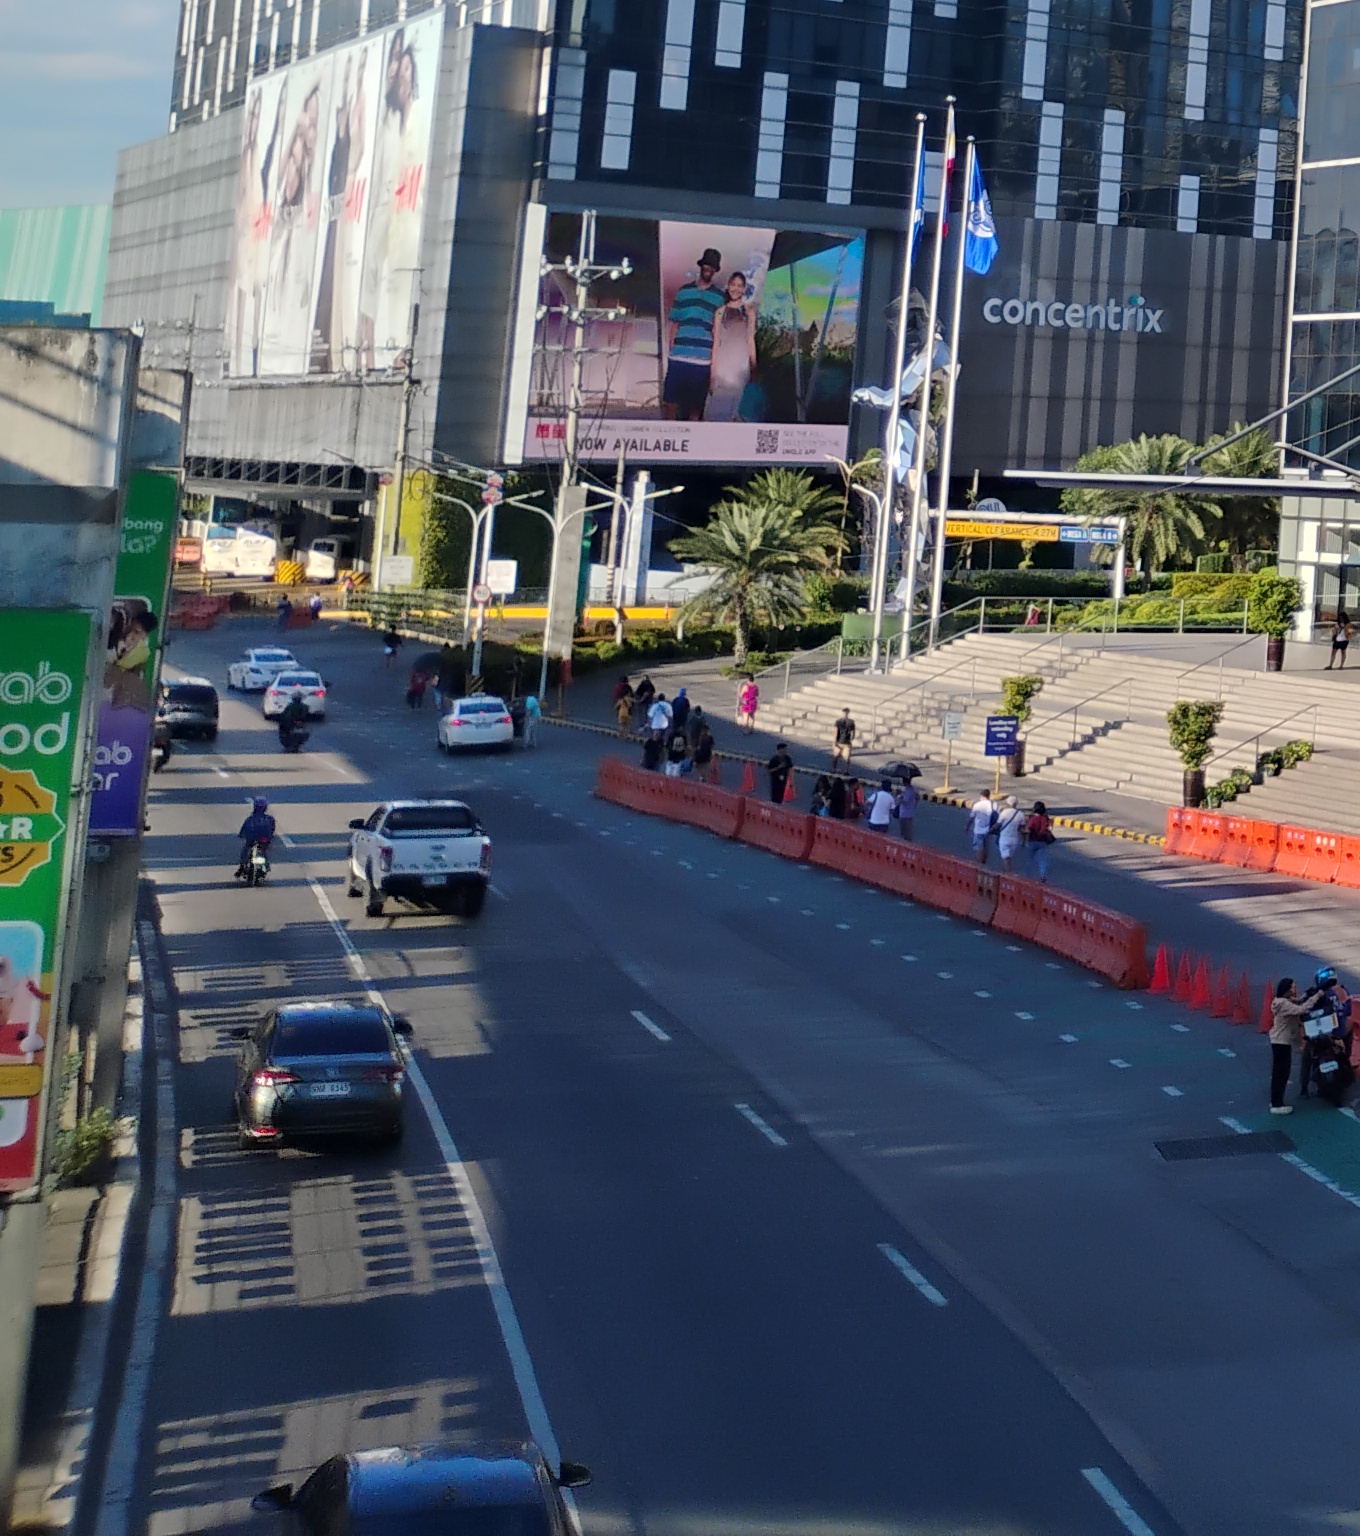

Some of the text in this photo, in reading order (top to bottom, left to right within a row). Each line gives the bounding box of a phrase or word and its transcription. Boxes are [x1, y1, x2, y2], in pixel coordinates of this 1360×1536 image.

[983, 296, 1164, 334] concentrix
[577, 437, 690, 453] NOW AVAILABLE
[946, 521, 981, 534] VERTICAL
[985, 524, 1031, 537] CLEARANCE
[121, 534, 157, 554] la?
[0, 660, 73, 705] ab
[0, 711, 71, 755] od
[95, 739, 133, 766] ab
[90, 773, 119, 791] ar
